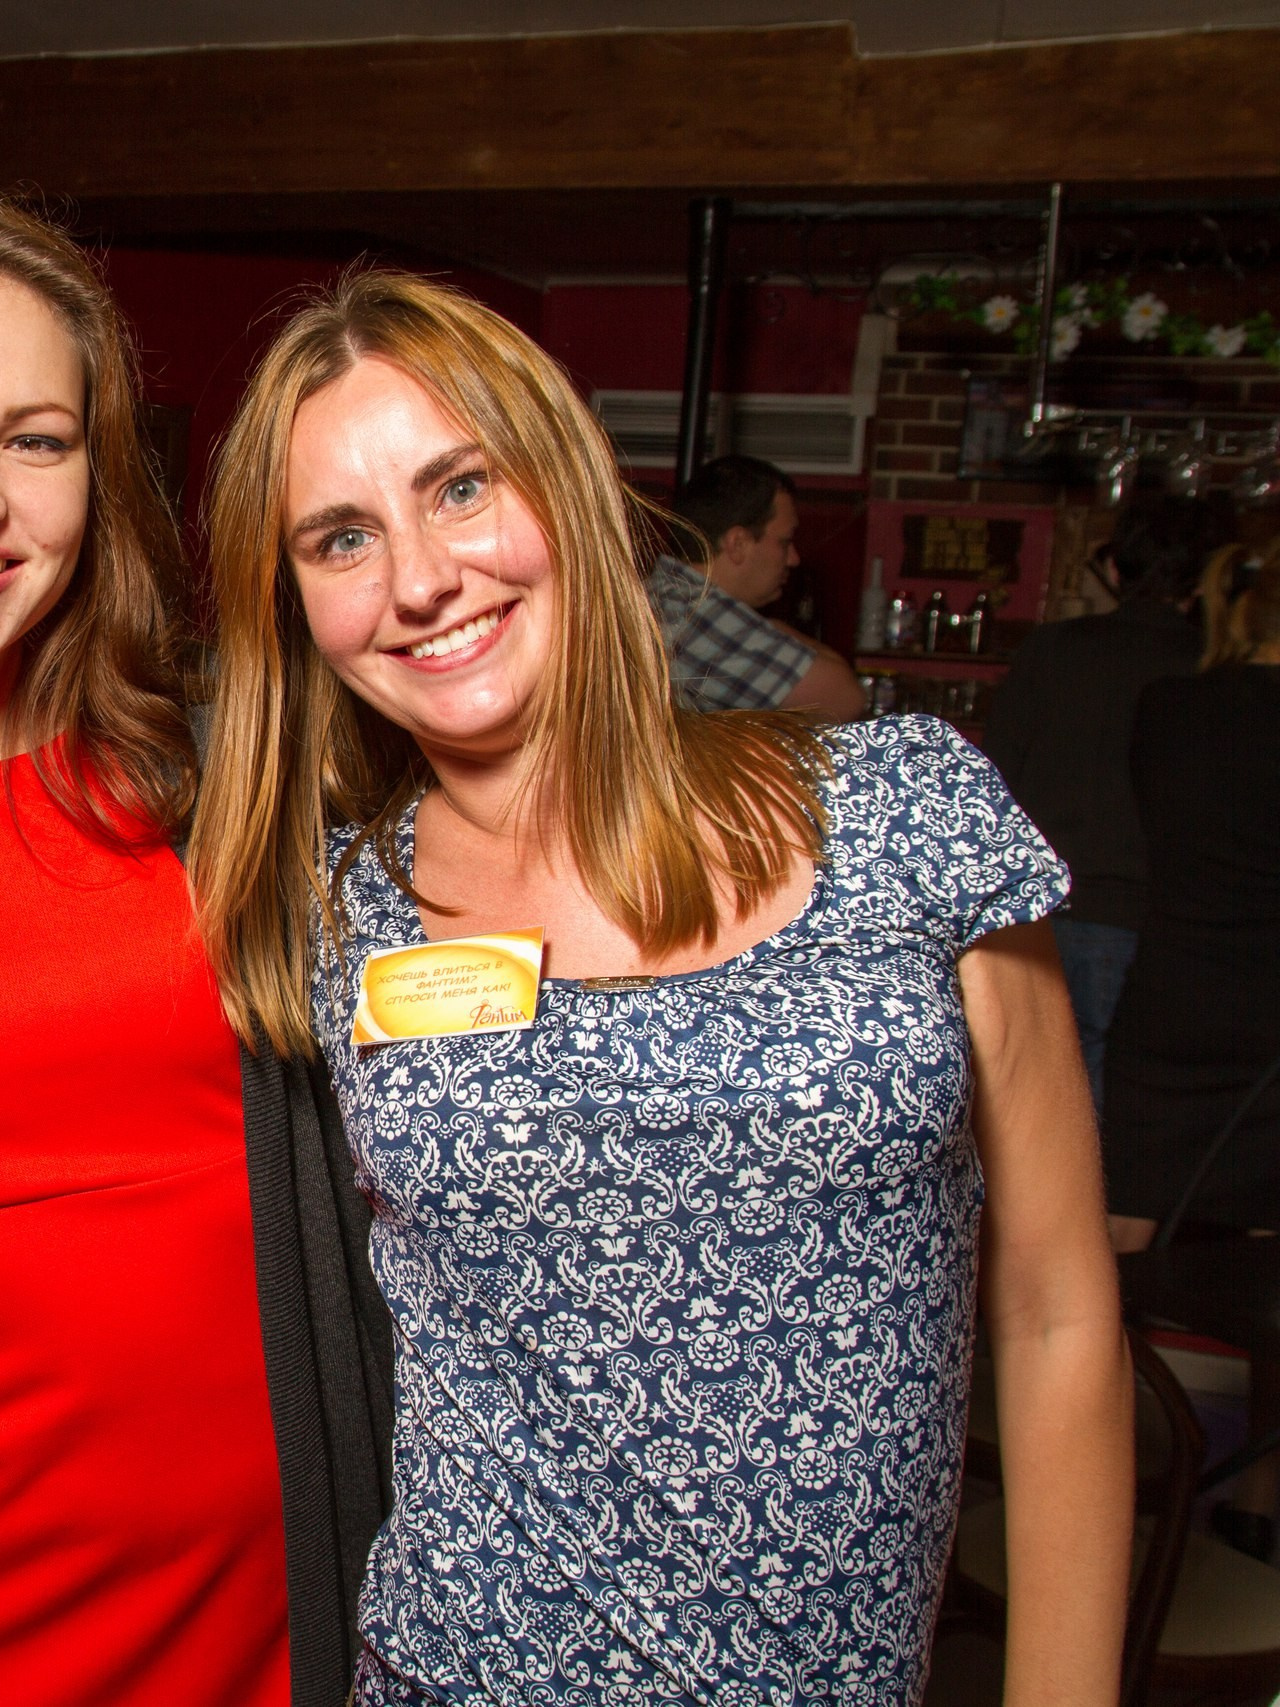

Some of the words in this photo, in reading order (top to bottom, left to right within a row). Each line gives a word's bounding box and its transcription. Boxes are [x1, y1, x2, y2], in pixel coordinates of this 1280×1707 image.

[377, 971, 428, 985] ХОЧЕШЬ
[433, 962, 491, 977] ВЛИТЬСЯ
[416, 975, 478, 990] ФАНТИМ?
[385, 992, 437, 1006] СПРОСИ
[441, 986, 478, 1000] МЕНЯ
